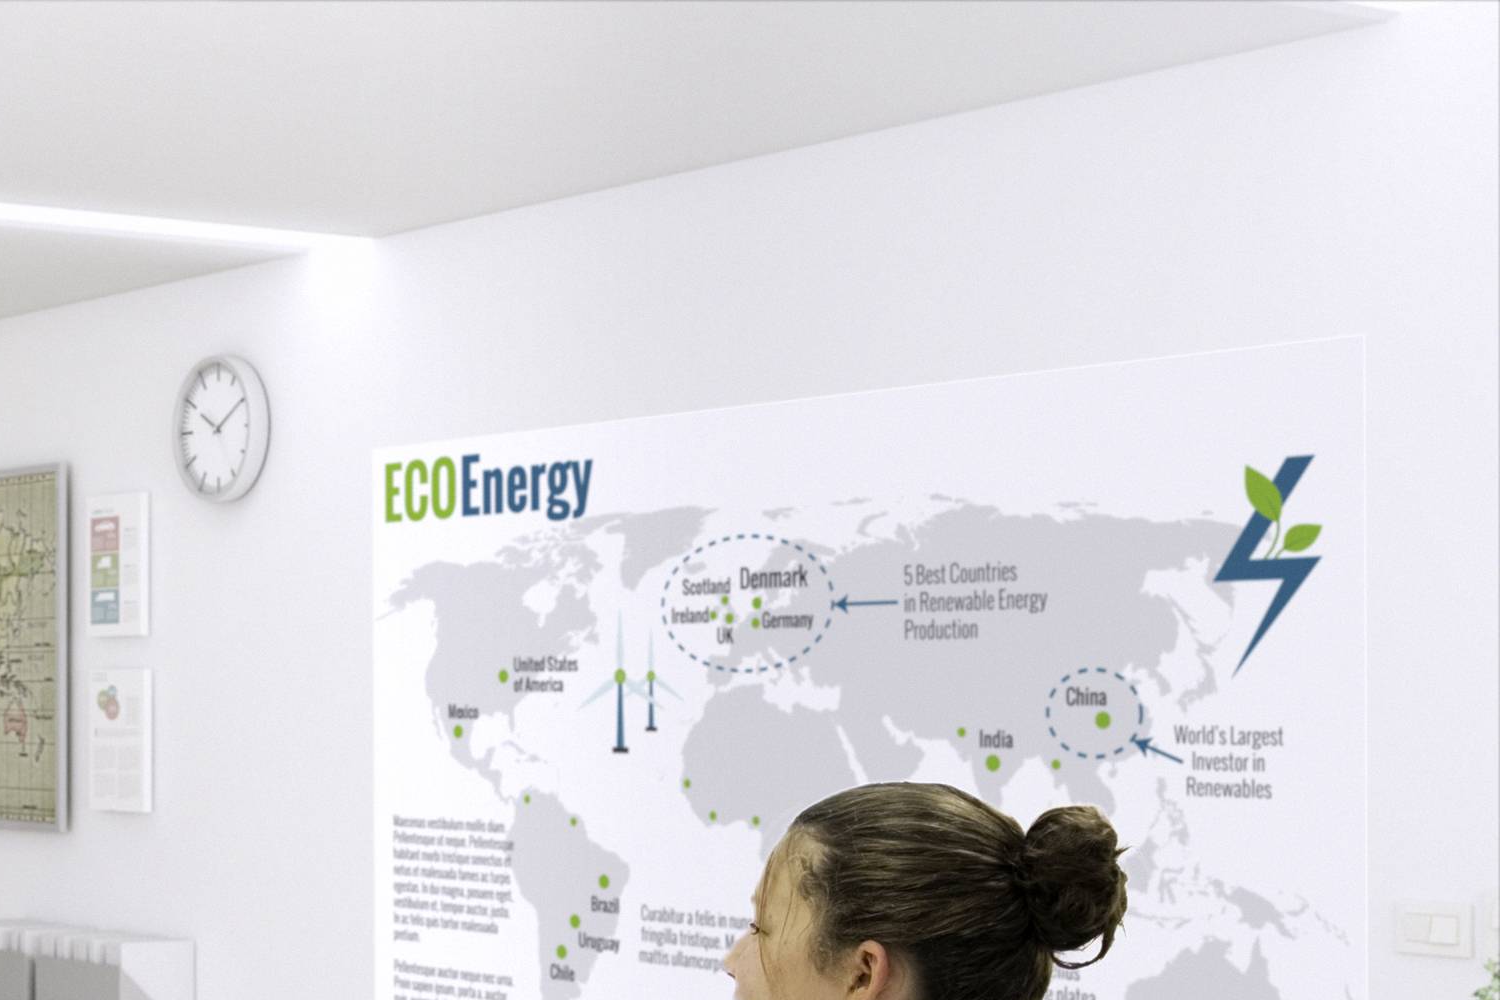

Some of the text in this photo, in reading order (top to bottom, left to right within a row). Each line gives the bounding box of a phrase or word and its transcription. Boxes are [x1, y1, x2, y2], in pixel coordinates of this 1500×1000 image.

[385, 452, 593, 522] ECOEnergy
[740, 566, 808, 590] Denmark
[904, 561, 1018, 584] 5 Best Countries
[682, 576, 731, 597] Scotland
[904, 590, 1048, 613] in Renewable Energy
[671, 606, 709, 625] Ireland
[762, 610, 814, 631] Germany
[717, 627, 734, 645] UK
[904, 619, 978, 641] Production
[513, 655, 578, 673] United States
[513, 676, 564, 693] of America
[1066, 686, 1107, 707] China
[448, 703, 479, 720] Mexico
[979, 730, 1014, 749] India
[1174, 725, 1283, 748] World's Largest
[1192, 751, 1265, 772] Investor in
[1186, 778, 1272, 800] Renewables
[591, 896, 620, 914] Brazil
[578, 932, 620, 954] Uruguay
[550, 963, 576, 982] Chile
